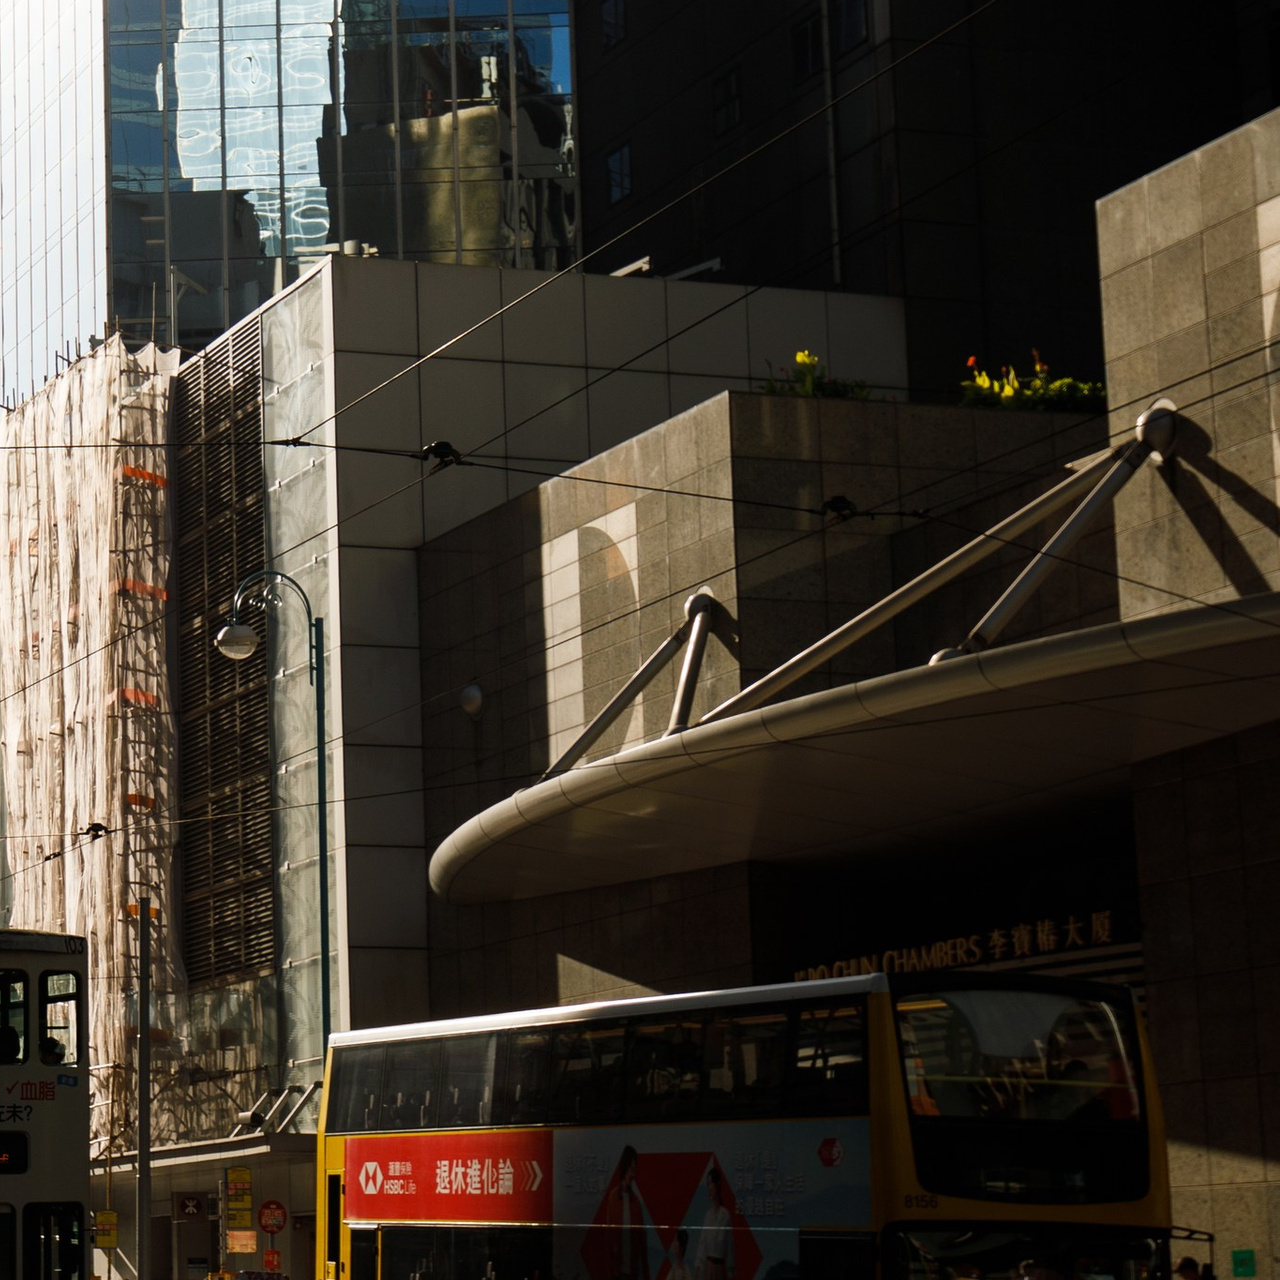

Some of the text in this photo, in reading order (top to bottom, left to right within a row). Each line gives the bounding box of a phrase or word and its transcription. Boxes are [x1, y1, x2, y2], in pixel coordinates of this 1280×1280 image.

[988, 909, 1113, 960] 李寶椿大廈
[64, 938, 84, 954] 103
[882, 933, 984, 974] CHAMBERS
[20, 1081, 56, 1101] 血脂
[435, 1158, 515, 1195] 退休進化論
[384, 1180, 417, 1195] HSBC Life
[904, 1195, 938, 1209] 8156
